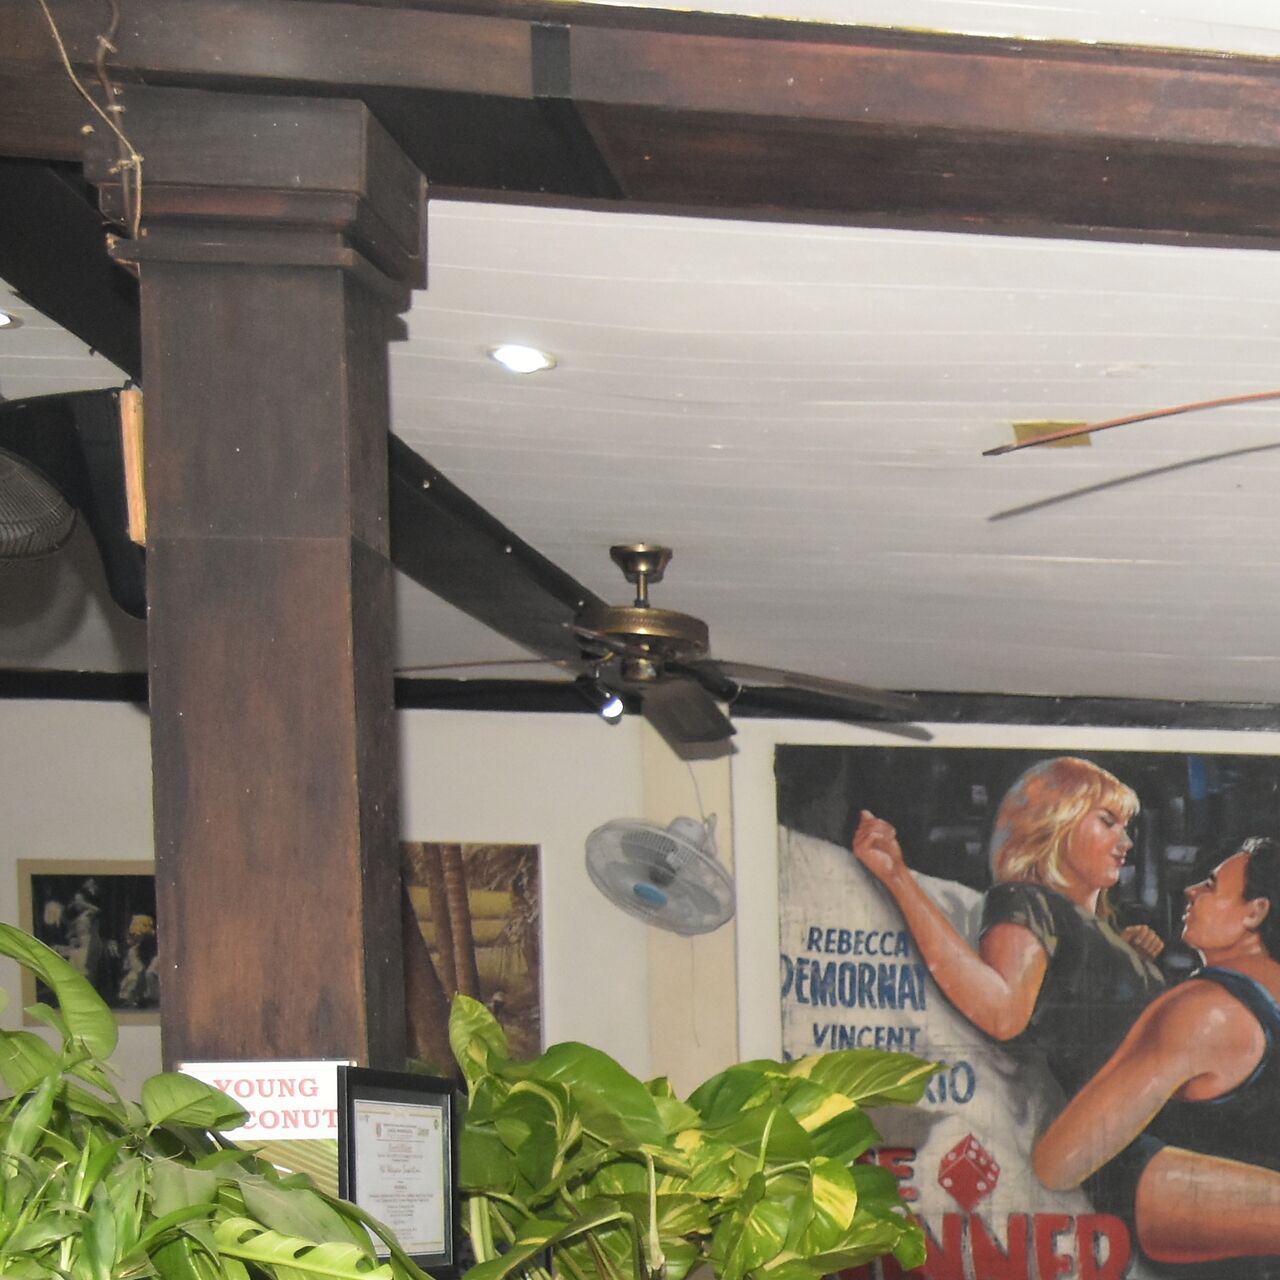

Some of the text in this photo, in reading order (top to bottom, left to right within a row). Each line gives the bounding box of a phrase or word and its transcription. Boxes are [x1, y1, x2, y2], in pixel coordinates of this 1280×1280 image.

[807, 926, 912, 958] REBECCA
[812, 1022, 921, 1052] VINCENT
[213, 1078, 319, 1099] YOUNG
[243, 1108, 337, 1131] CONUT
